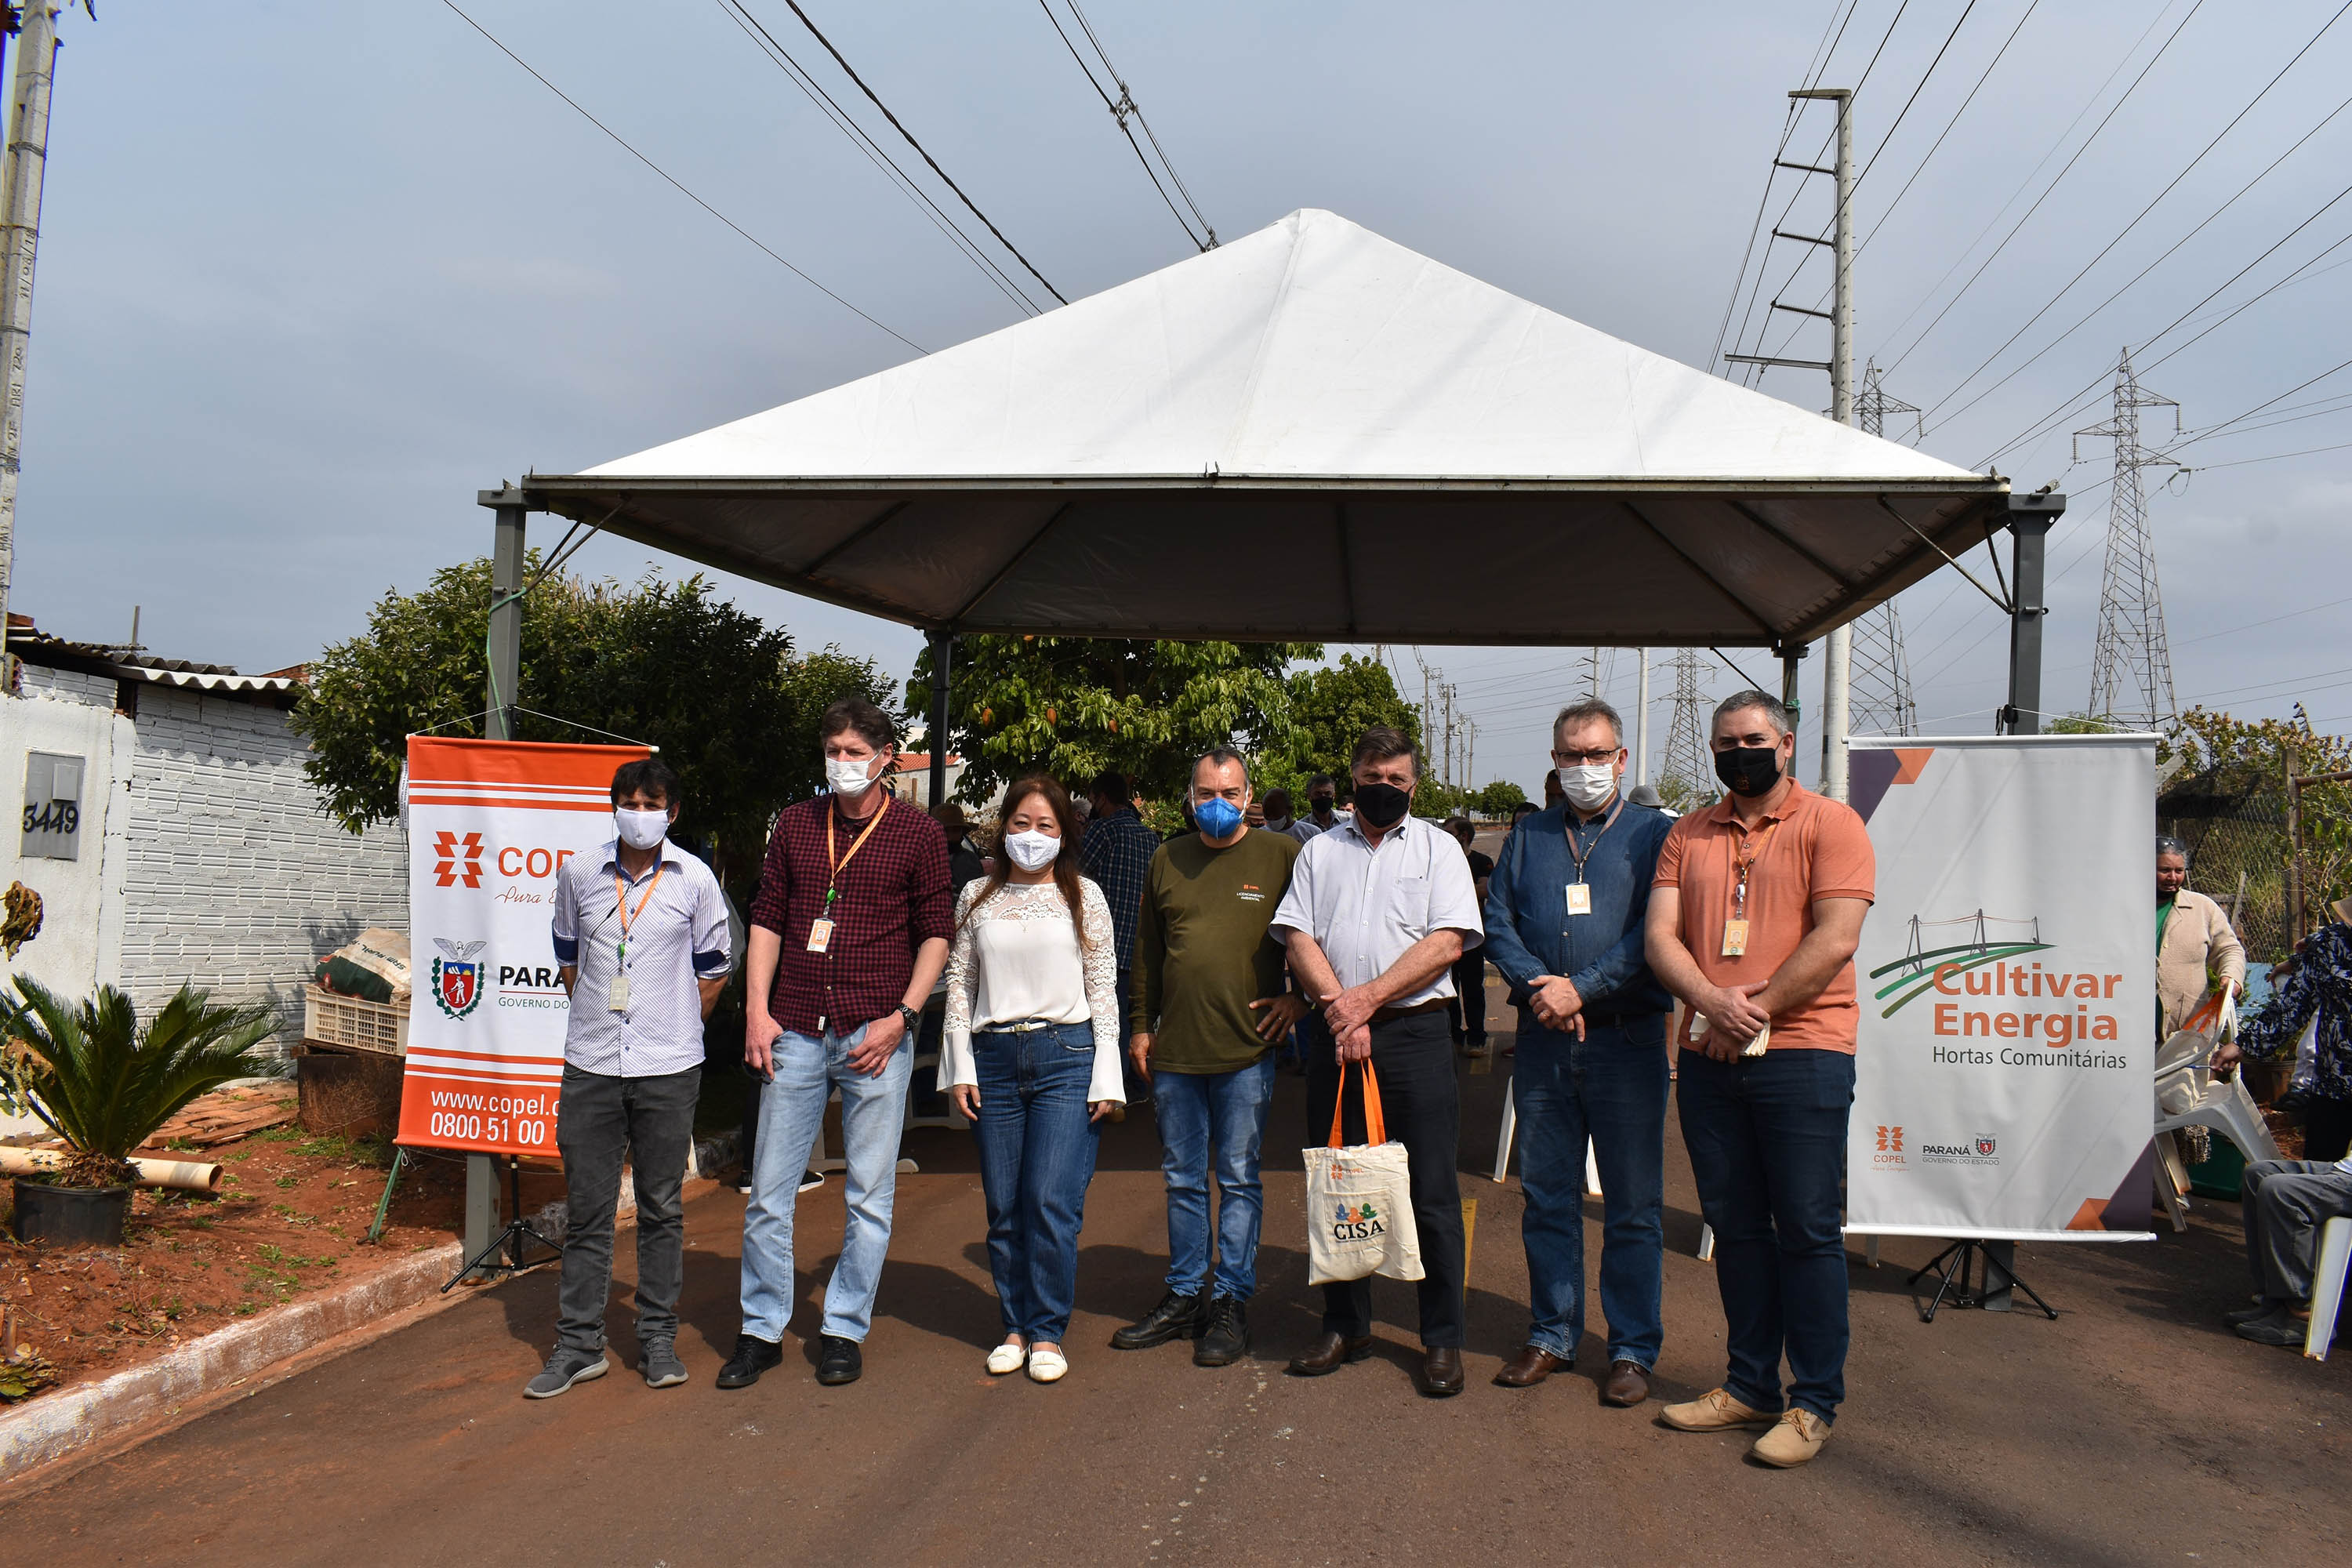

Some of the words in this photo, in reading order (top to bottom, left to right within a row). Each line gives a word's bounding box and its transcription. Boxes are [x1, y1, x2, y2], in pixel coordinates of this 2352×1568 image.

[22, 802, 79, 834] 3449
[495, 886, 542, 903] Pura
[1933, 962, 2122, 999] Cultivar
[499, 996, 551, 1008] GOVERNO
[554, 1000, 570, 1009] DO
[1934, 1004, 2118, 1048] Energia
[1933, 1046, 1993, 1065] Hortas
[2000, 1048, 2127, 1069] Comunitárias
[430, 1112, 481, 1140] 0800
[487, 1117, 509, 1142] 51
[518, 1120, 545, 1145] 00
[1874, 1155, 1907, 1163] COPEL
[1922, 1145, 1971, 1156] PARANÁ
[1334, 1220, 1385, 1240] CISA
